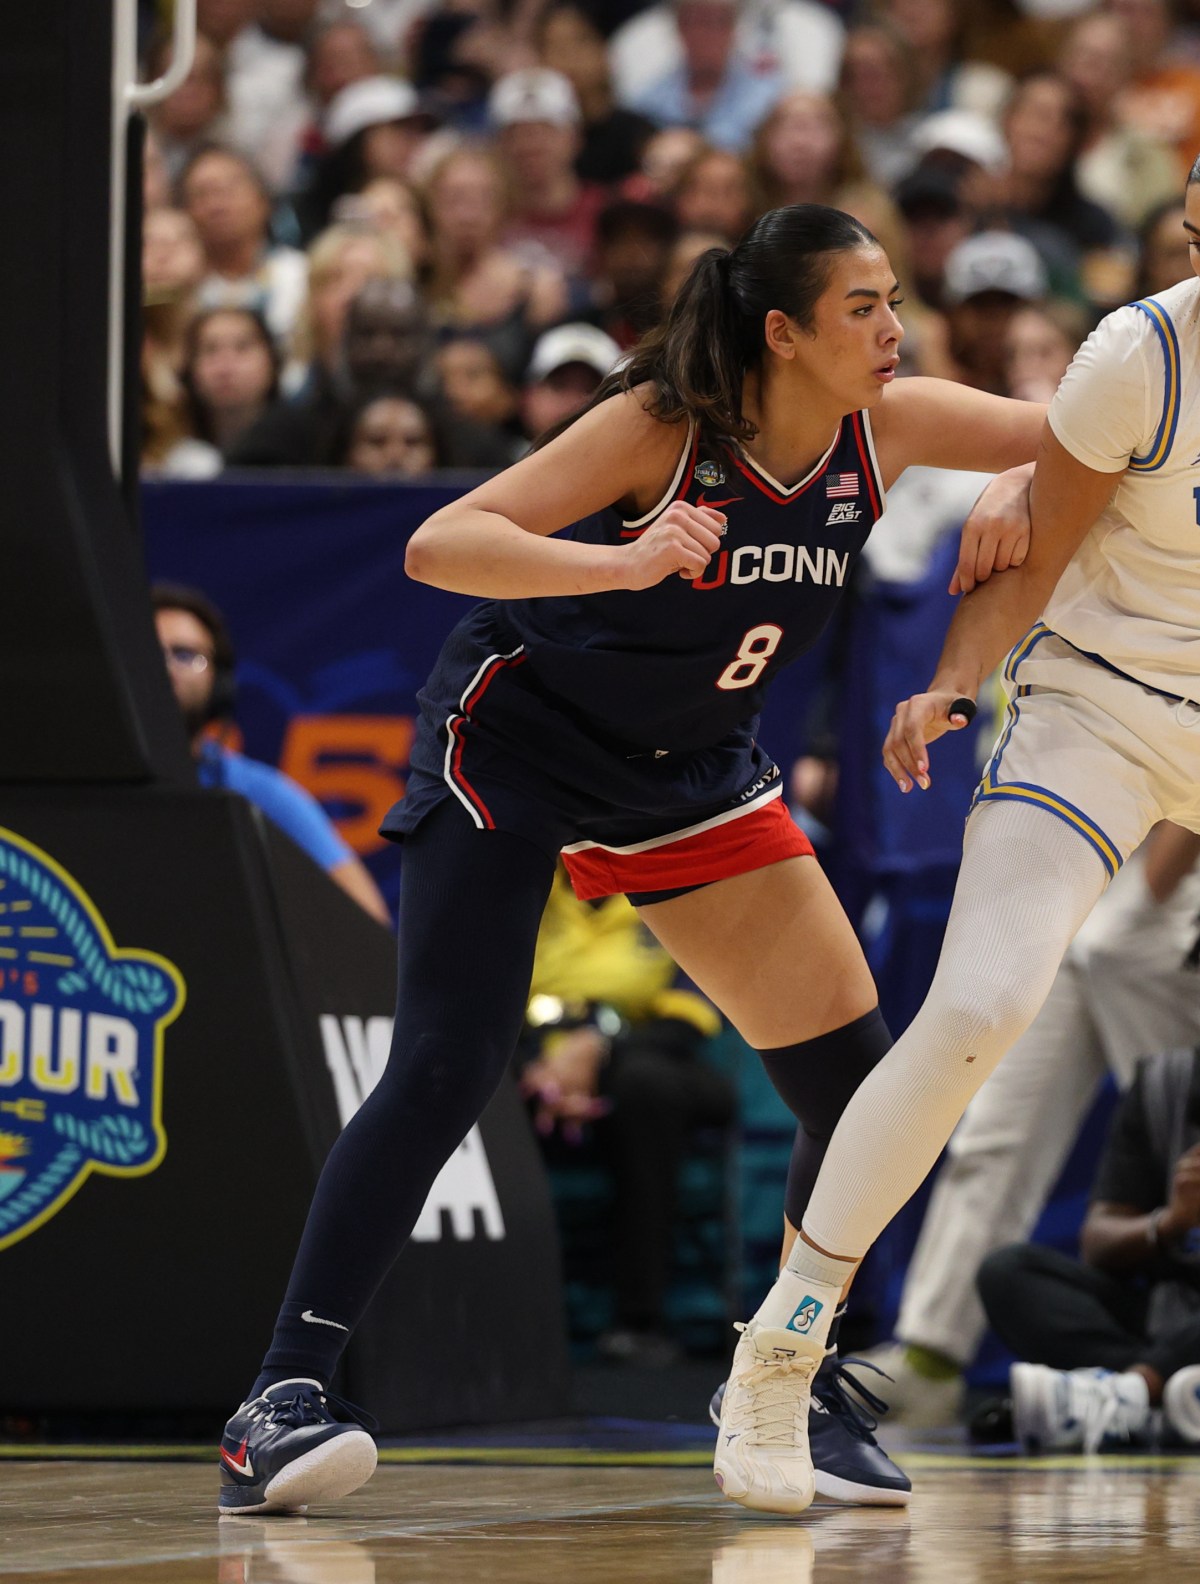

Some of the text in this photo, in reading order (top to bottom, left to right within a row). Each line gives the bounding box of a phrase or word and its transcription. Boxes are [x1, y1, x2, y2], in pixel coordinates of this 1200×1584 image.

[827, 510, 863, 522] EAST
[831, 502, 856, 513] BIG
[691, 543, 849, 590] UCONN
[714, 622, 784, 690] 8
